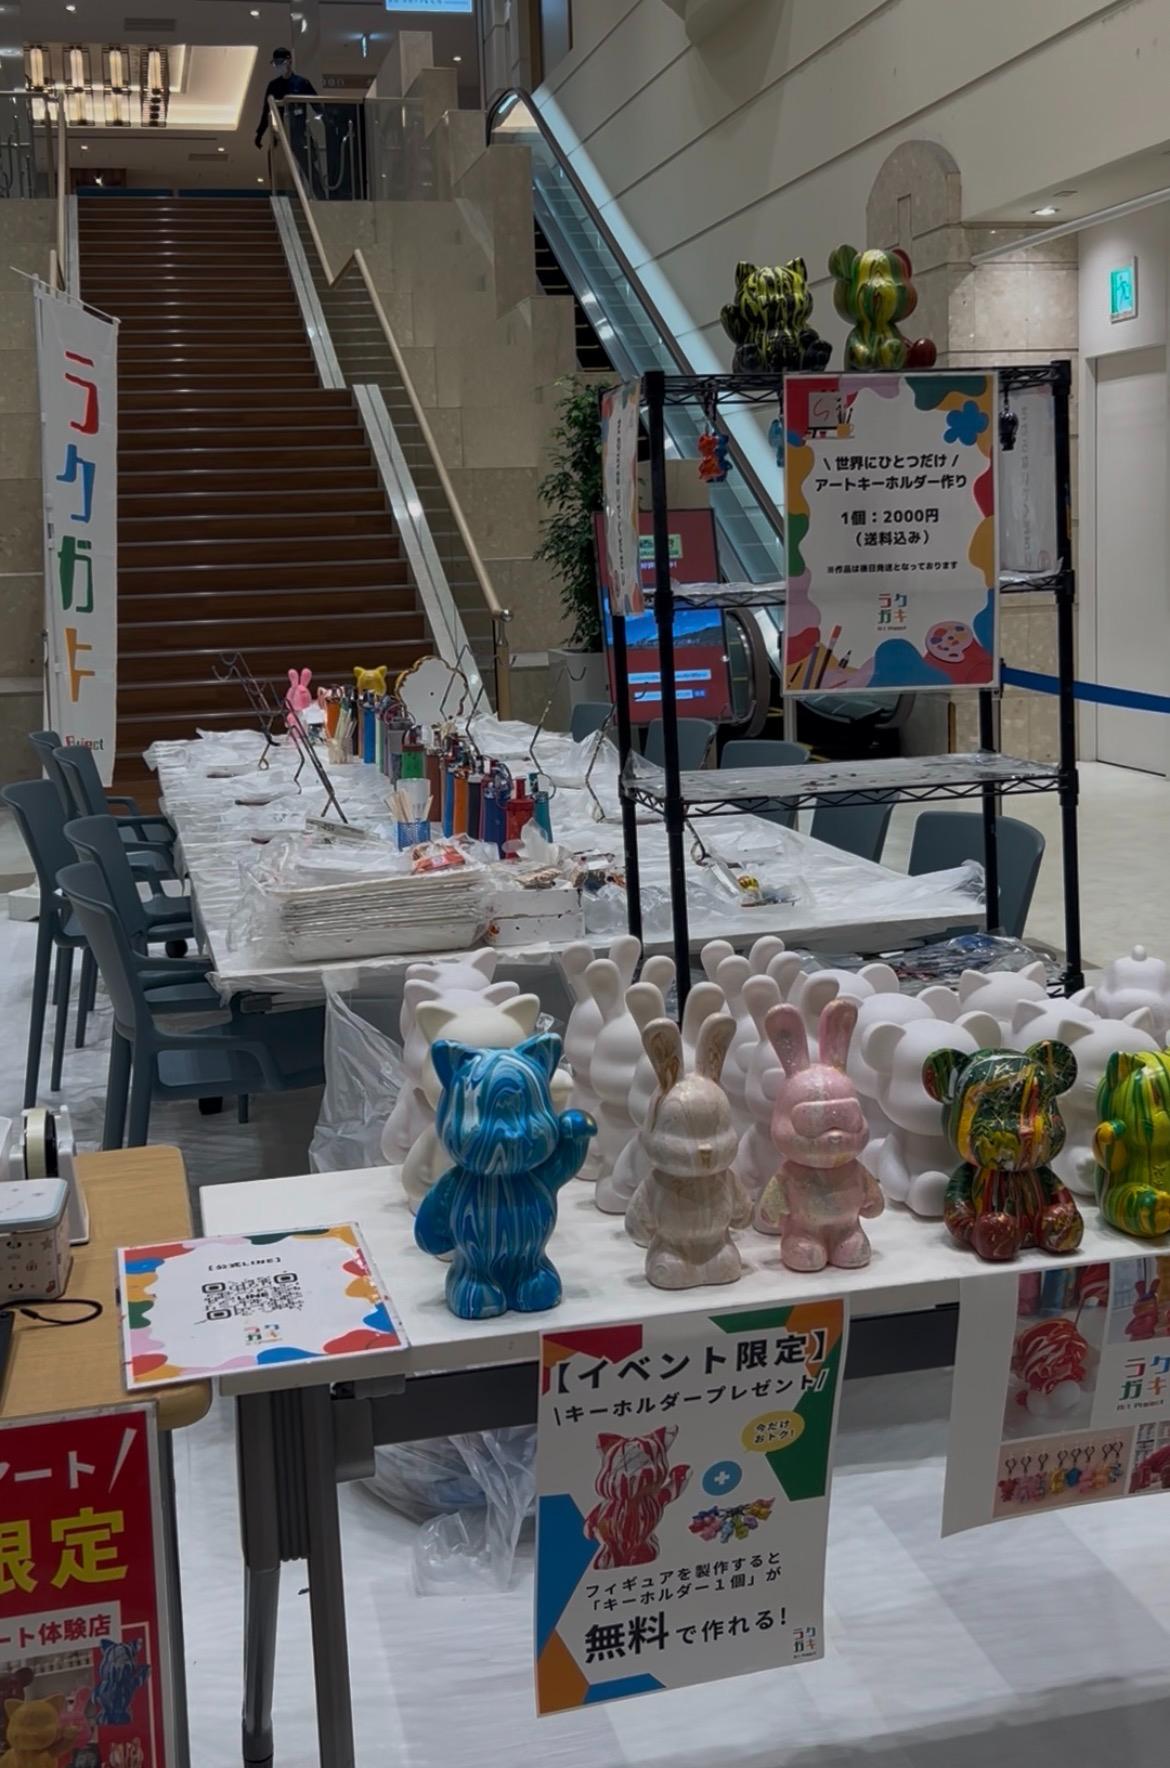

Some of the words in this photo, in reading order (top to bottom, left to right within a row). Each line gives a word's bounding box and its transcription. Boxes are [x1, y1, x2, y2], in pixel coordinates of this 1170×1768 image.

[836, 454, 947, 470] 世界にひとつだけ
[815, 474, 967, 492] アートキーホルダー作り
[841, 508, 939, 526] 1個：2000円
[855, 529, 931, 547] （送料込み）
[558, 1329, 826, 1394] 【イベント限定】
[756, 1420, 791, 1432] 今だけ
[754, 1430, 795, 1443] おトク!
[0, 1449, 96, 1490] ート
[586, 1551, 781, 1598] フィギュアを製作すると
[585, 1607, 788, 1664] 無料で作れる!
